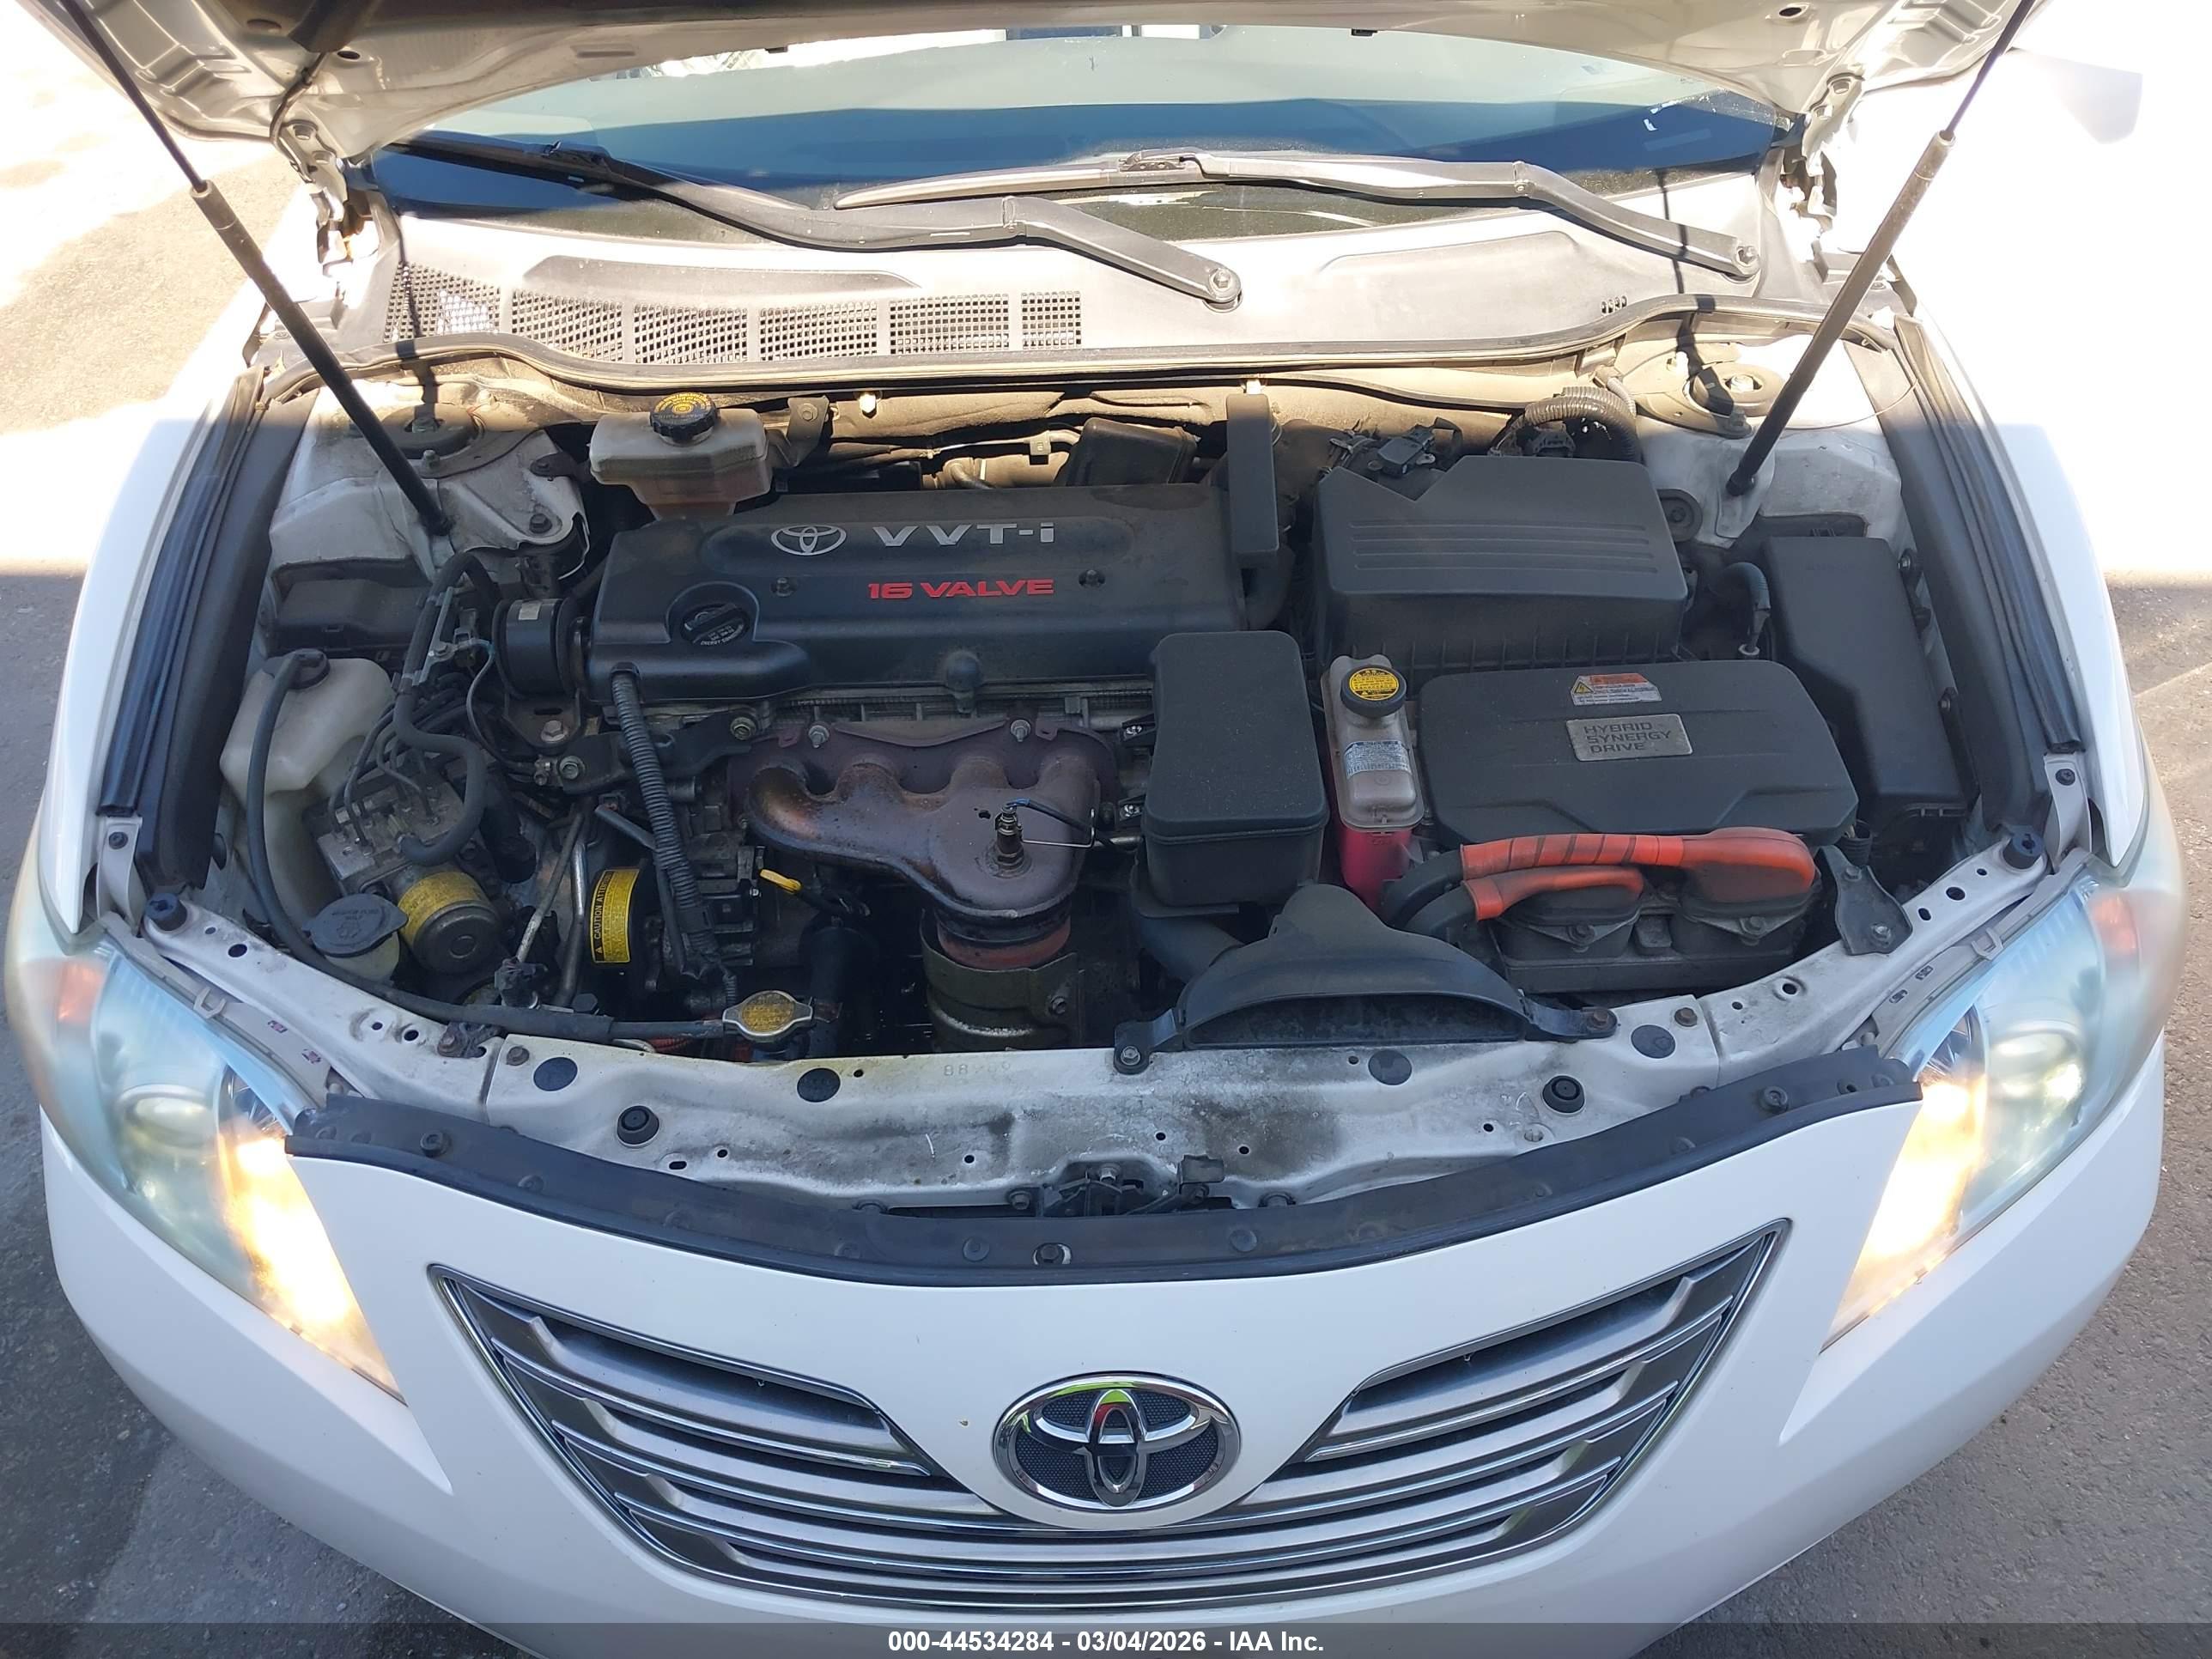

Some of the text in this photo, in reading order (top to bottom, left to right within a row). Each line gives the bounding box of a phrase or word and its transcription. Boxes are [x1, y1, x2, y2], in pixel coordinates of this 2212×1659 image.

[872, 522, 1055, 547] VVT-i
[868, 579, 1054, 599] 16 VALVE
[1583, 722, 1653, 734] HYBRID
[1586, 730, 1672, 744] SYNERGY
[1589, 742, 1646, 755] DRIVE
[593, 905, 603, 939] CAUTION
